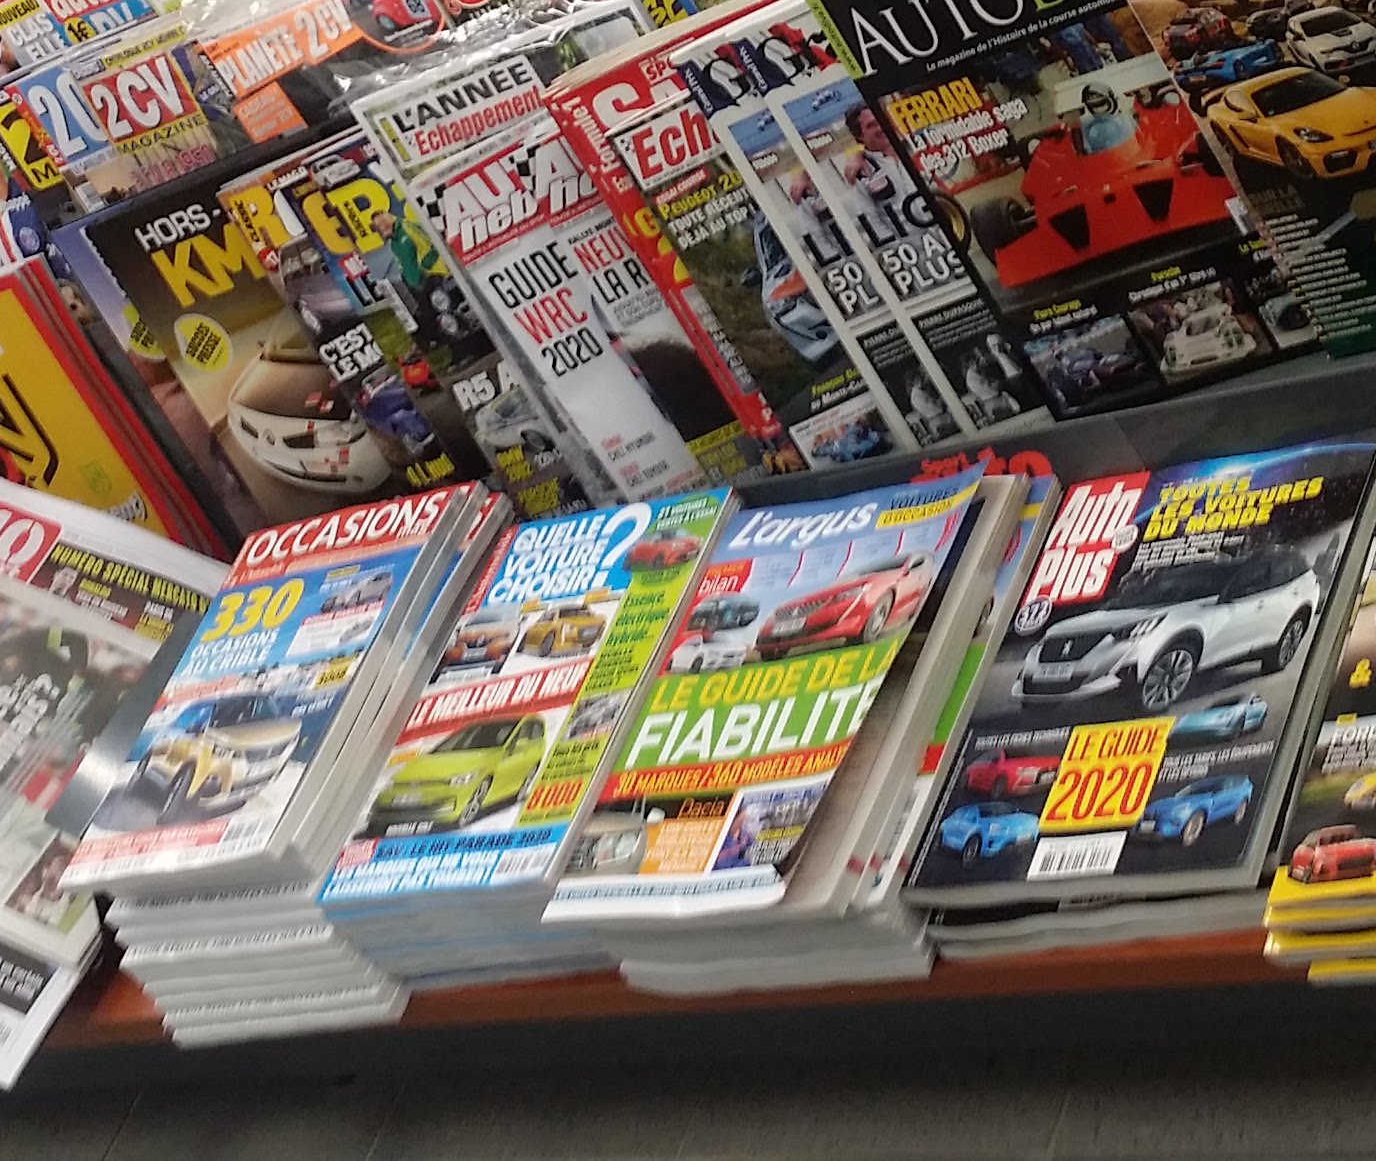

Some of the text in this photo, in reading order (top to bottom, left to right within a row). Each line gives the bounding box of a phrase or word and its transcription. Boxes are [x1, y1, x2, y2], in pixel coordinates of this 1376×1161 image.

[90, 52, 188, 143] 2CV
[393, 59, 531, 132] L'ANNÉE
[892, 77, 982, 137] FERRARI
[488, 240, 580, 310] GUIDE
[515, 289, 587, 344] WRC
[542, 327, 604, 377] 2020
[1151, 477, 1324, 522] LES VOITURES
[1160, 476, 1252, 503] TOUTES
[246, 488, 450, 567] OCCASIONS
[514, 513, 603, 552] QUELLE
[727, 502, 878, 549] L'argus
[1185, 504, 1274, 534] MONDE
[502, 542, 603, 578] VOITURE
[699, 571, 740, 593] bilan
[1031, 548, 1117, 602] Plus
[204, 579, 306, 638] 330
[651, 651, 851, 713] LE GUIDE DE
[1067, 723, 1171, 762] LE GUIDE
[1046, 762, 1153, 822] 2020
